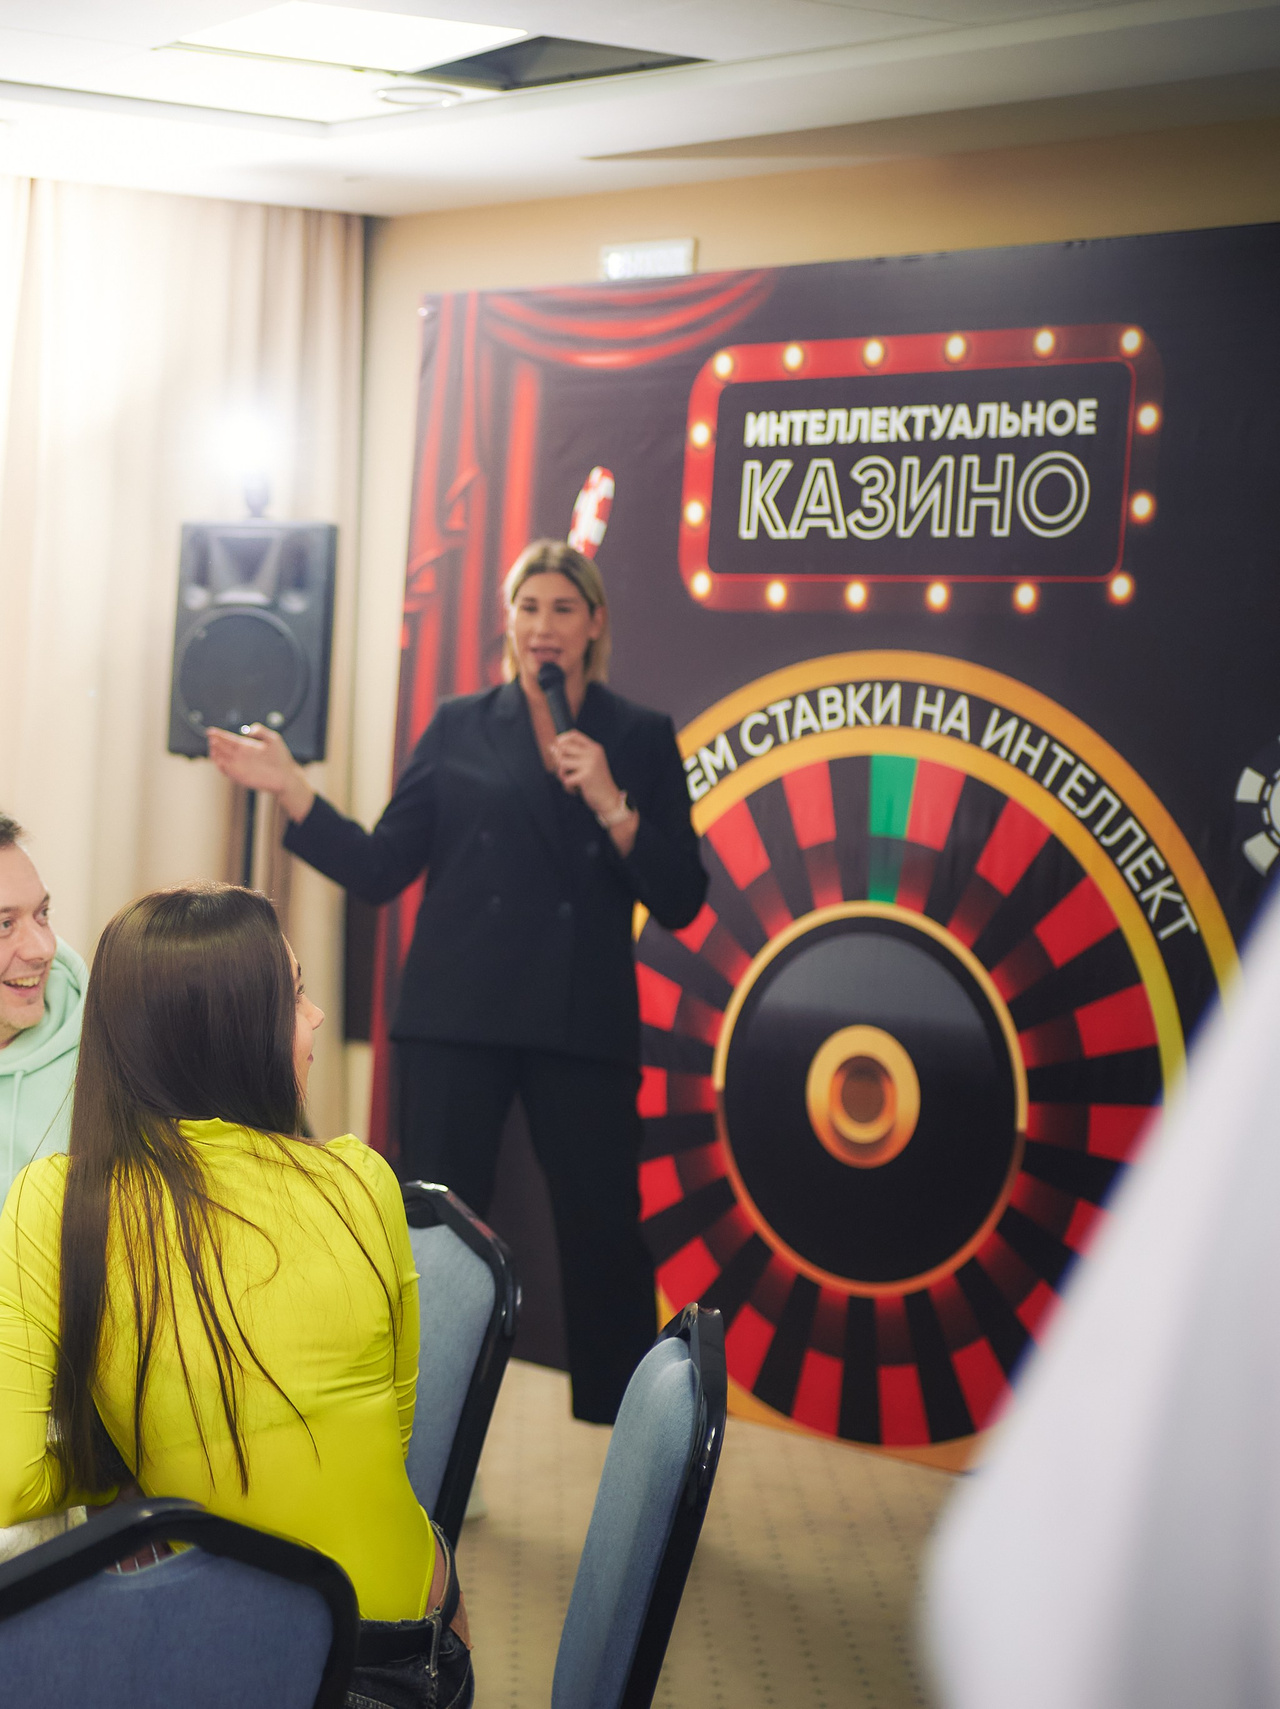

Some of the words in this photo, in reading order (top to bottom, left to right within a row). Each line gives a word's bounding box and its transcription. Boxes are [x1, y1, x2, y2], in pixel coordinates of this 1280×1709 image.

[744, 399, 1098, 446] ИНТЕЛЛЕКТУАЛЬНОЕ
[739, 451, 1090, 540] КАЗИНО
[683, 732, 738, 802] ЕМ
[739, 682, 902, 757] СТАВКИ
[912, 686, 972, 743] НА
[981, 708, 1200, 940] ИНТЕЛЛЕКТ
